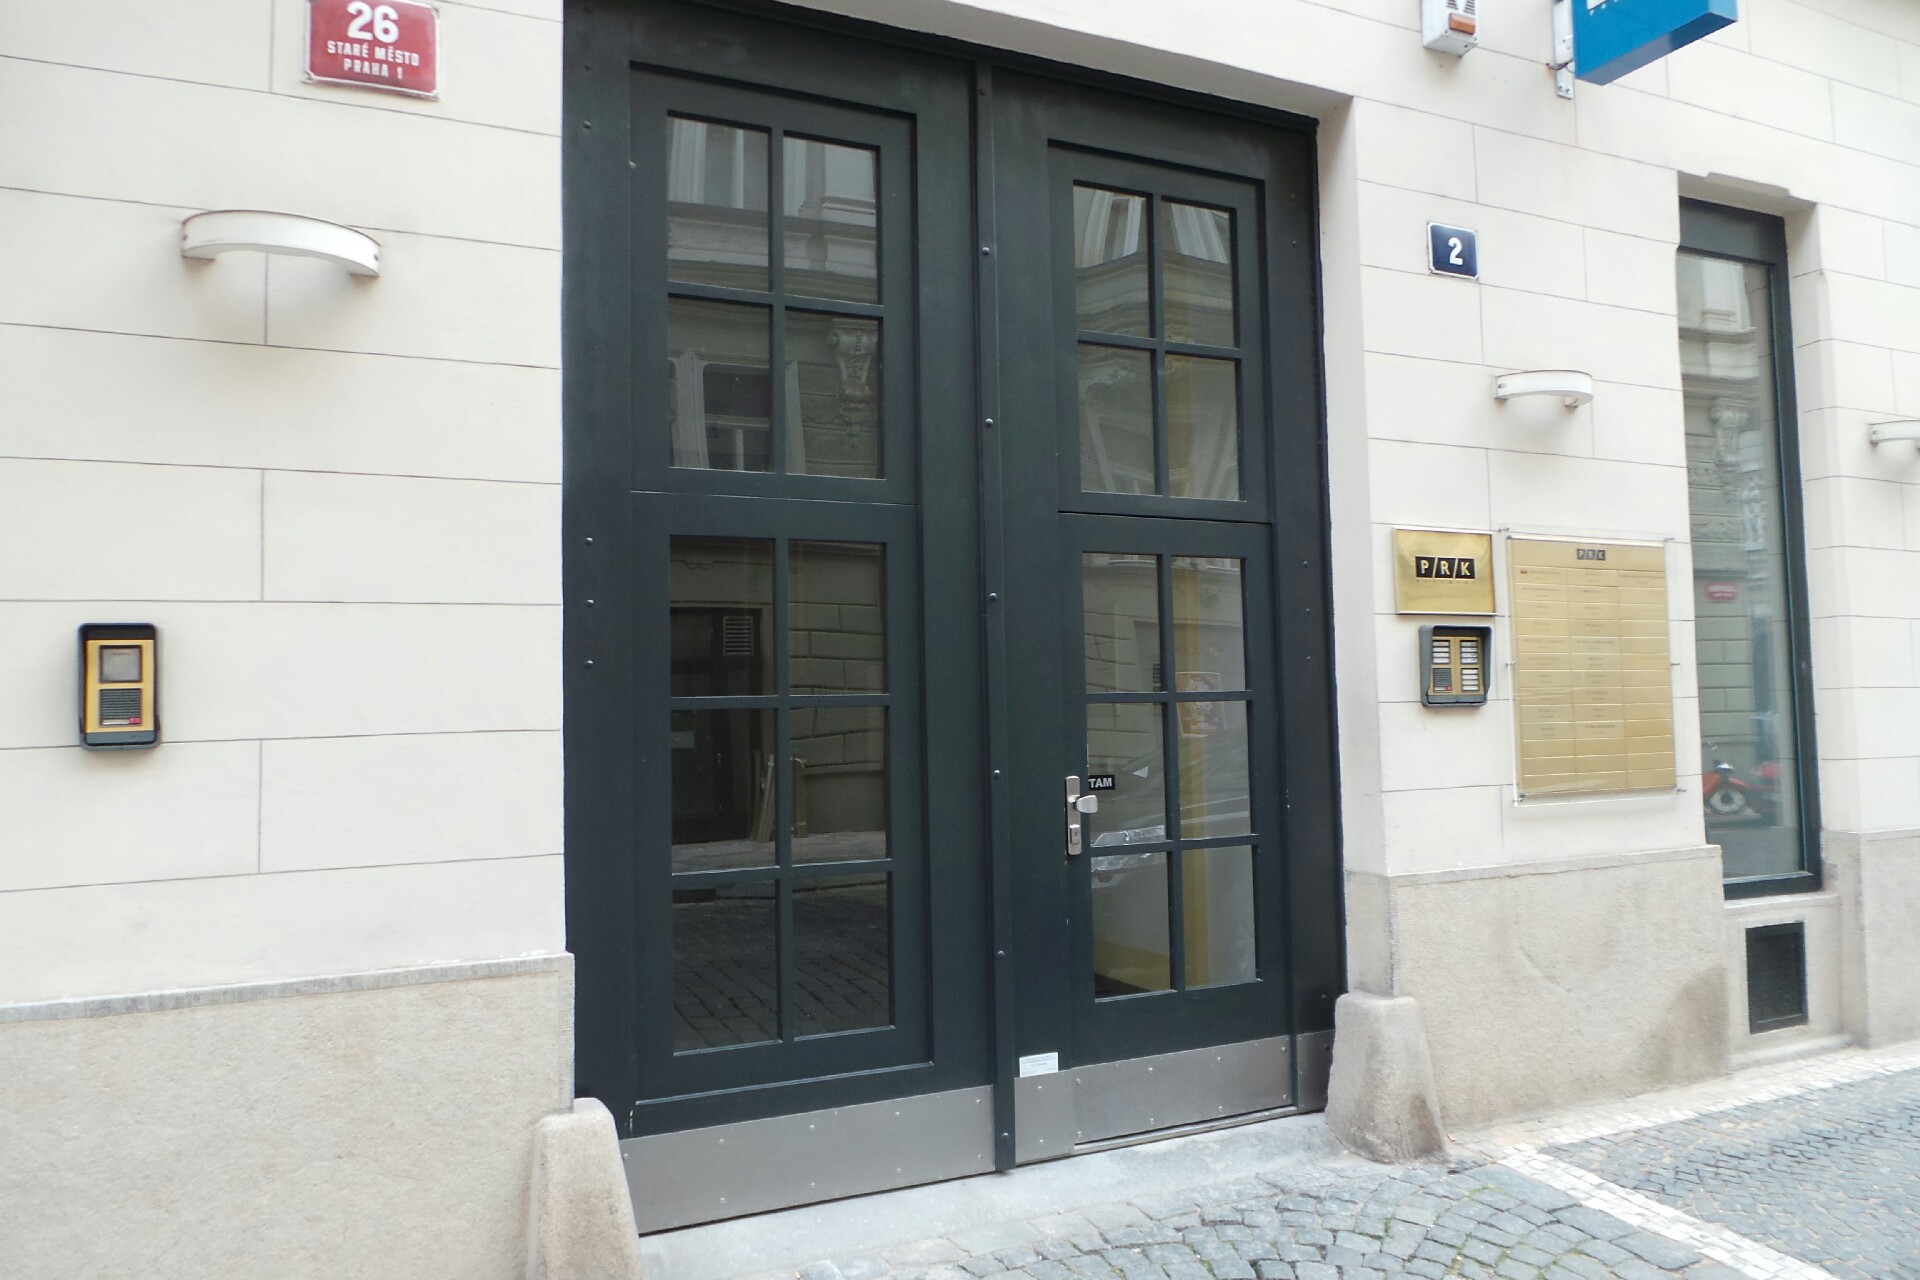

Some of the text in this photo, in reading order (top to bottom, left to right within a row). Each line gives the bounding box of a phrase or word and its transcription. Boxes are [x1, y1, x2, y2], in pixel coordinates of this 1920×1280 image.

[347, 1, 399, 43] 26
[327, 40, 419, 67] STARÉ MĚSTO
[343, 58, 403, 80] PRAHA 1
[1448, 237, 1463, 265] 2
[1088, 777, 1113, 789] TAM
